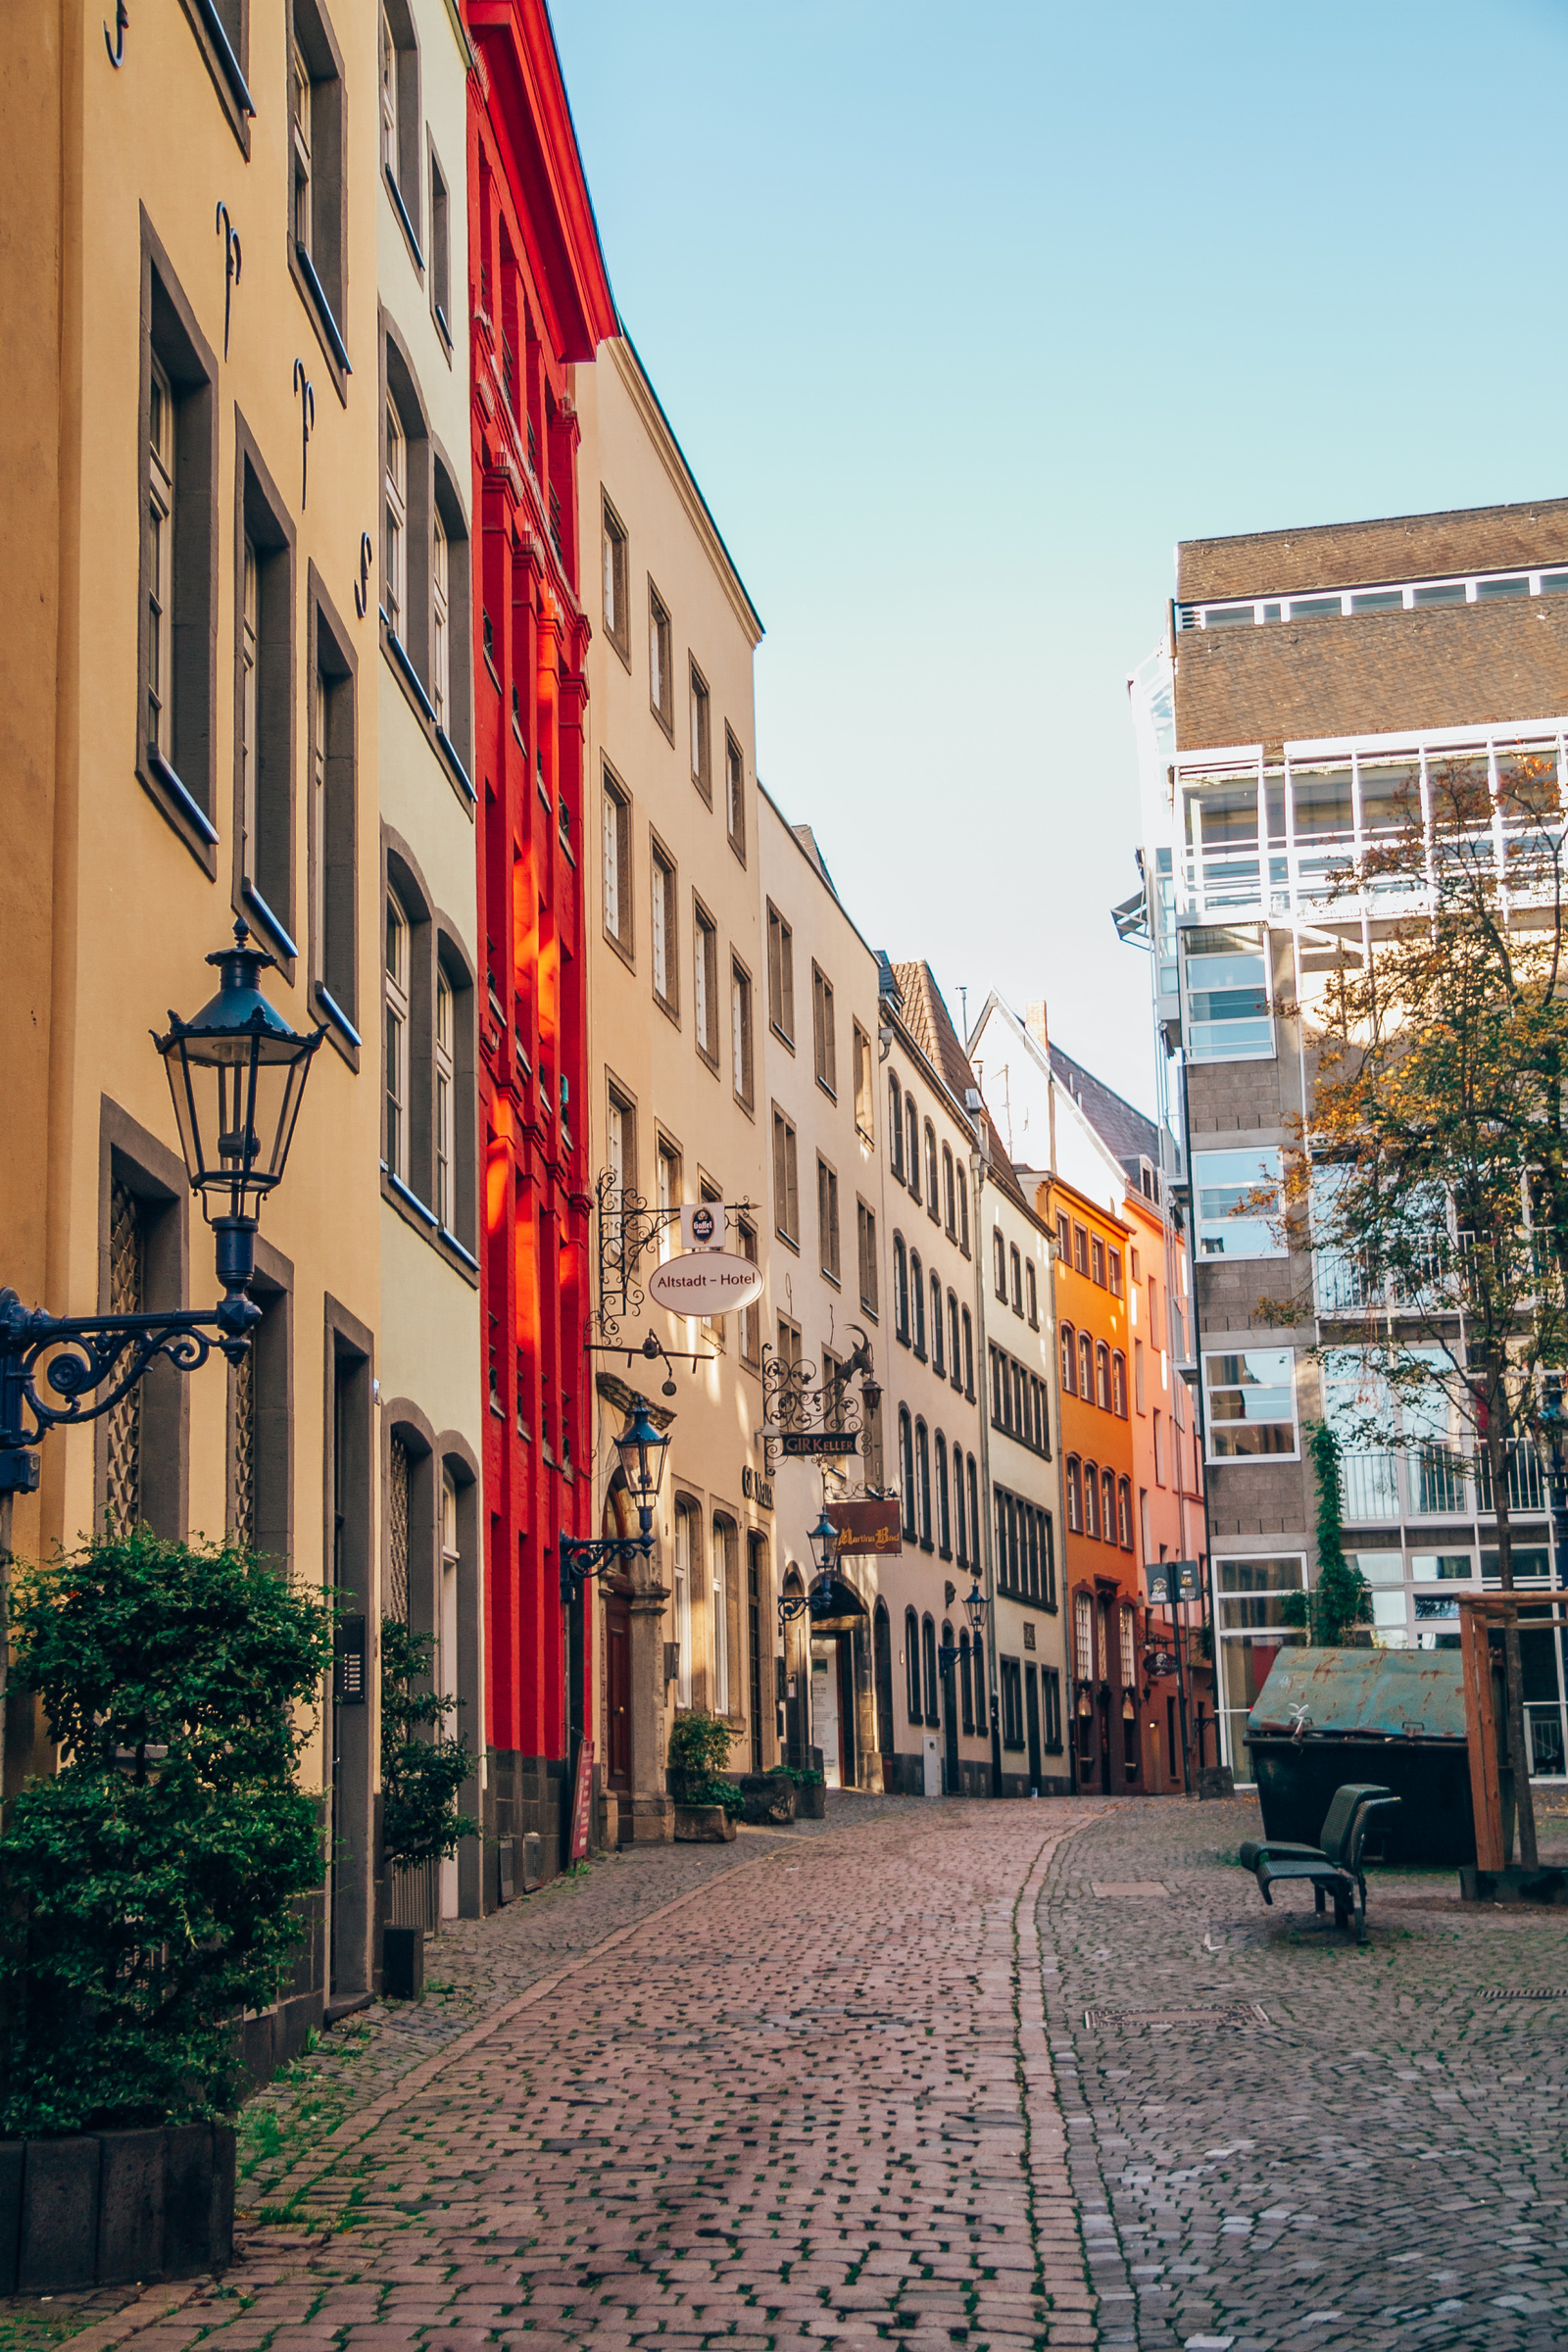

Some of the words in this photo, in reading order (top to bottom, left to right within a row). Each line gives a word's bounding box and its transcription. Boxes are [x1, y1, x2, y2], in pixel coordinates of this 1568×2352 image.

[693, 1220, 712, 1230] Gaffel
[658, 1274, 707, 1288] Altstadt
[720, 1272, 756, 1285] Hotel
[874, 1526, 900, 1549] Bad
